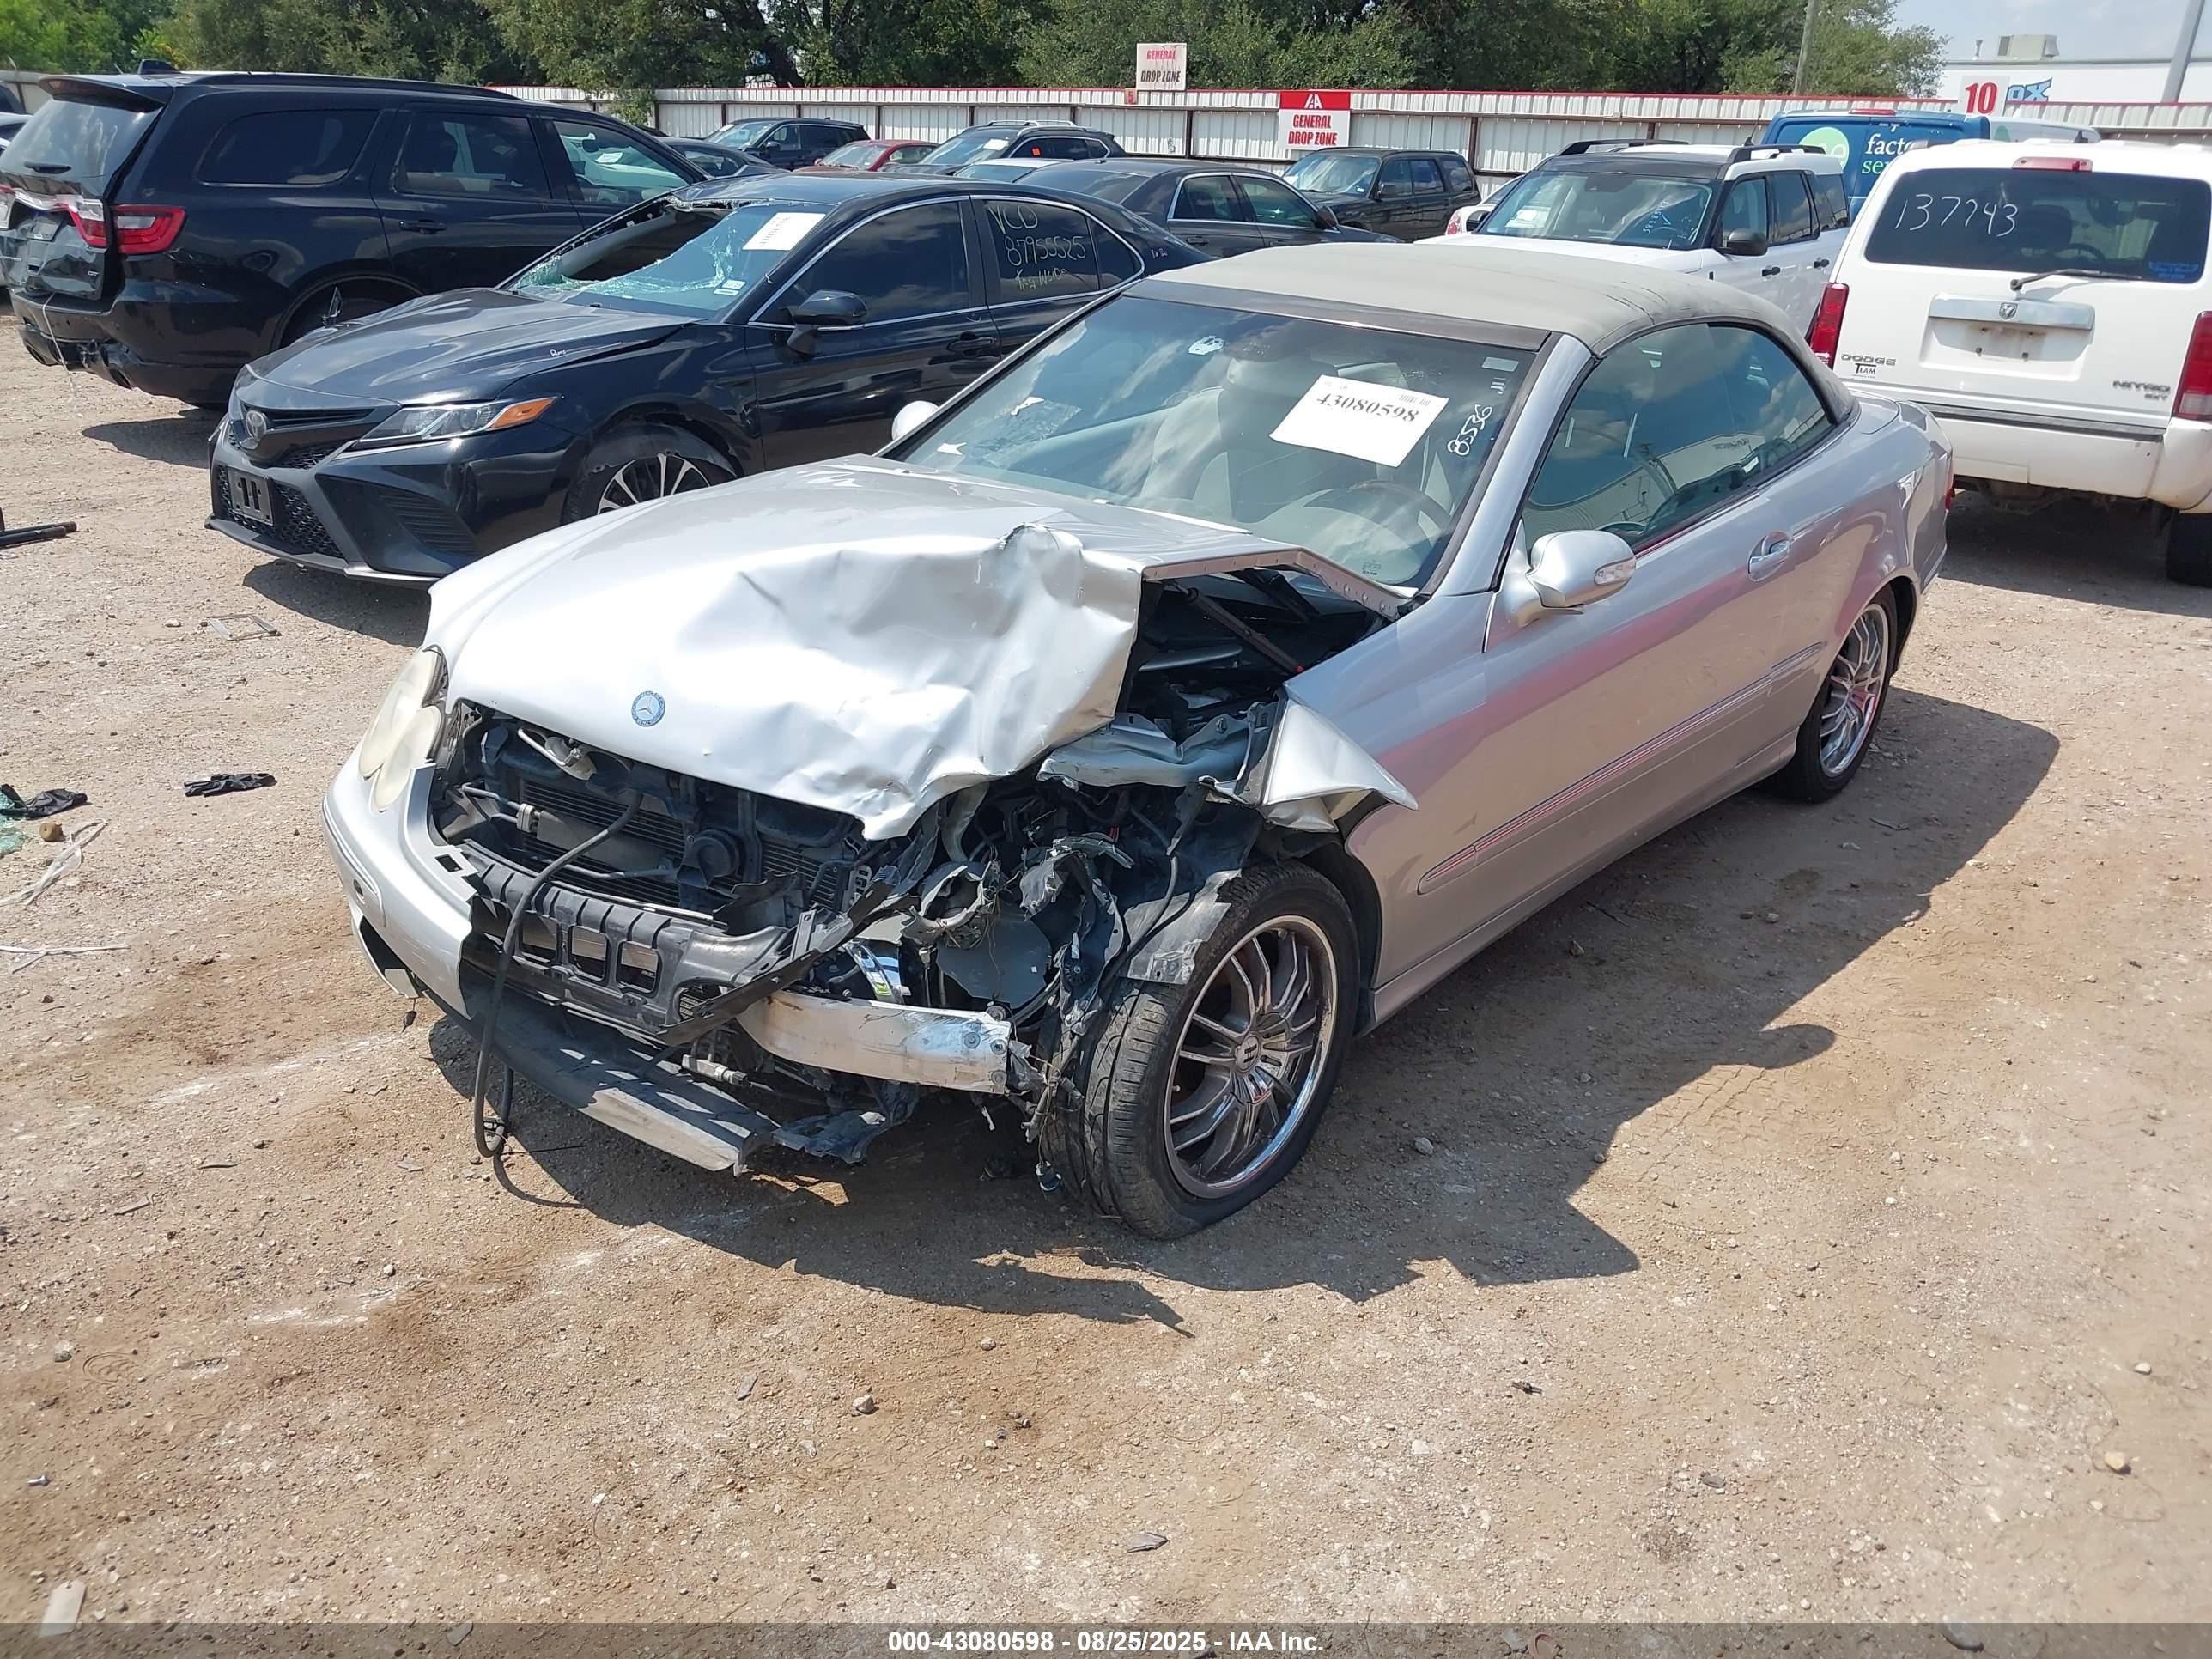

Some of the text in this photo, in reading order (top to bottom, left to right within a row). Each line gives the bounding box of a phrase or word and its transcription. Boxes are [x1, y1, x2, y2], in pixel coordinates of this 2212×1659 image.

[1146, 50, 1176, 59] GENERAL
[1140, 70, 1181, 83] DROP ZONE
[1965, 82, 1998, 114] 10
[1293, 114, 1332, 129] GENERAL
[1288, 131, 1338, 146] DROP ZONE
[1005, 235, 1086, 267] 87955525
[1841, 354, 1897, 366] DODGE
[1316, 392, 1420, 422] 43080598
